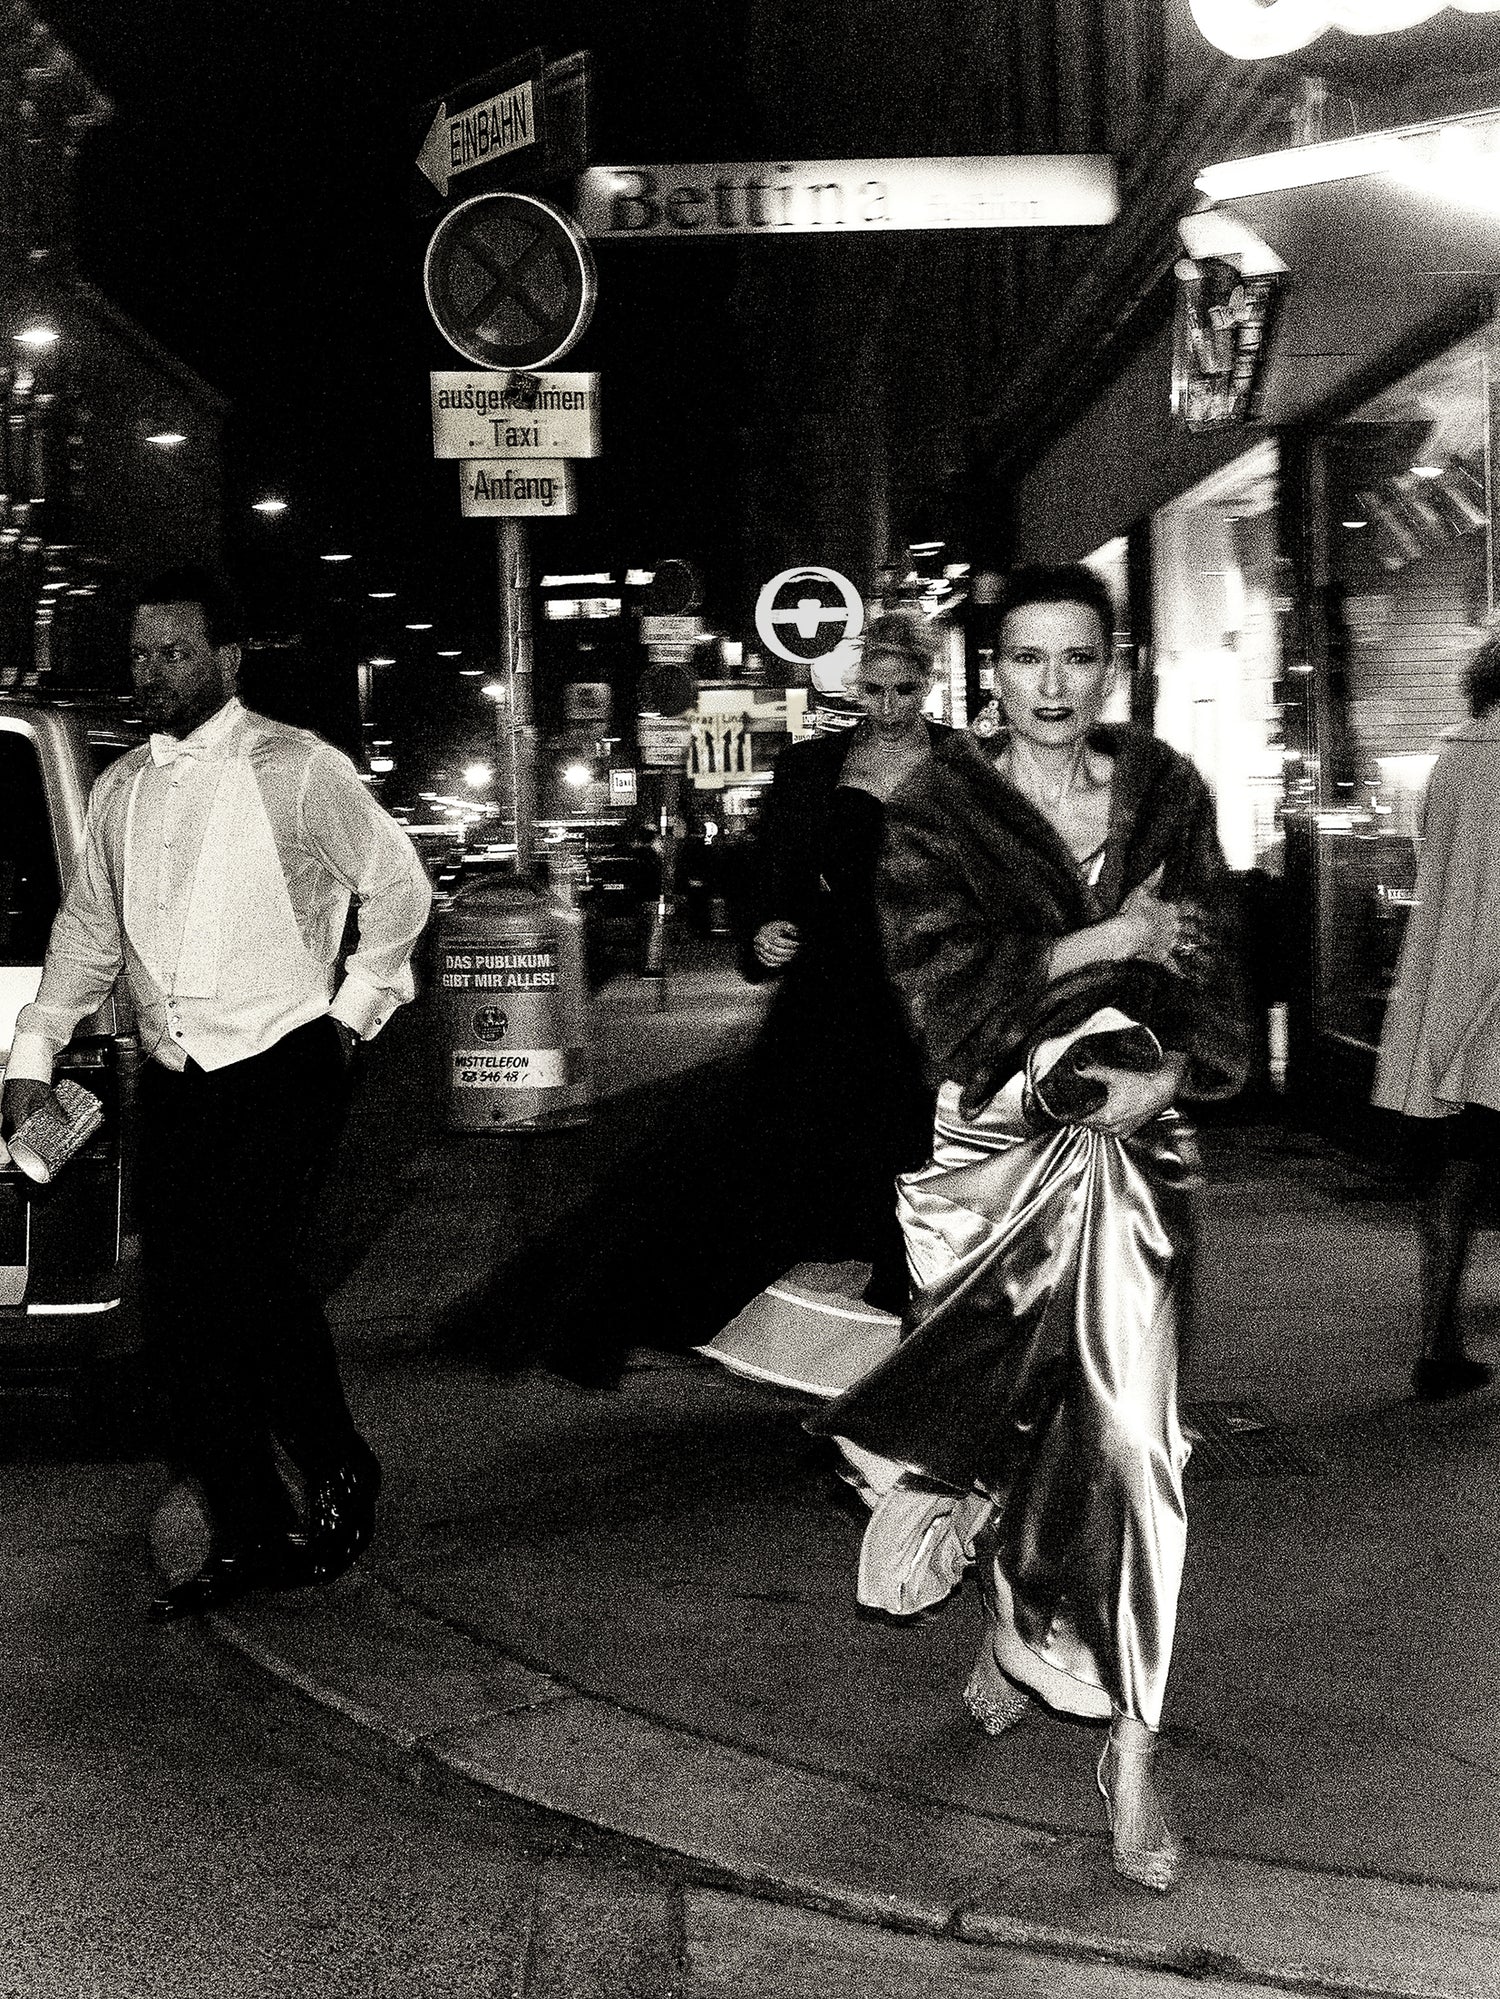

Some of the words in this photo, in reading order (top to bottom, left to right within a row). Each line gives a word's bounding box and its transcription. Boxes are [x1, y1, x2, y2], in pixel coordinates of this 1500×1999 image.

[450, 92, 527, 167] EINBAHN
[608, 166, 889, 231] Bettina
[489, 419, 539, 447] Taxi
[474, 470, 552, 506] Anfang
[446, 955, 472, 969] DAS
[475, 954, 550, 968] PUBLIKUM
[443, 973, 471, 987] GIBT
[474, 973, 503, 987] MIR
[507, 972, 555, 987] ALLES!
[455, 1056, 529, 1068] MISTTELEFON
[479, 1070, 501, 1082] 546
[503, 1070, 519, 1082] 48
